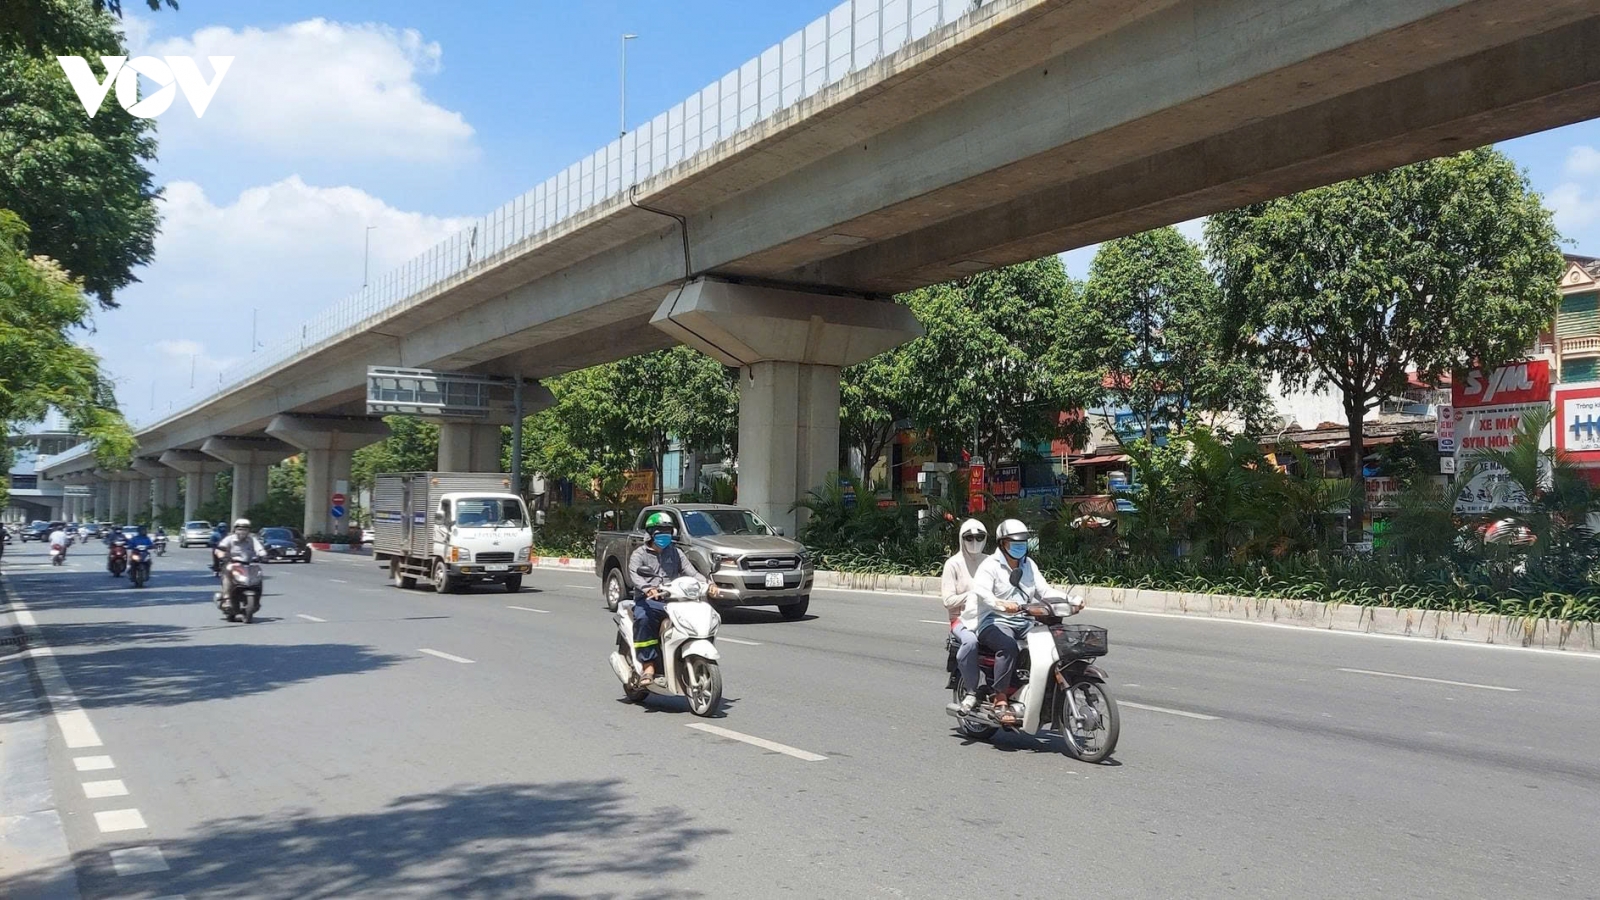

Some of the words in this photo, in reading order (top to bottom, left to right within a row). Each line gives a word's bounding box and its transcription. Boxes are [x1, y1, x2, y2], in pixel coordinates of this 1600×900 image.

[1464, 364, 1534, 402] SYM
[1479, 419, 1493, 431] XE
[1496, 415, 1520, 430] MÁY
[1462, 437, 1486, 448] SYM
